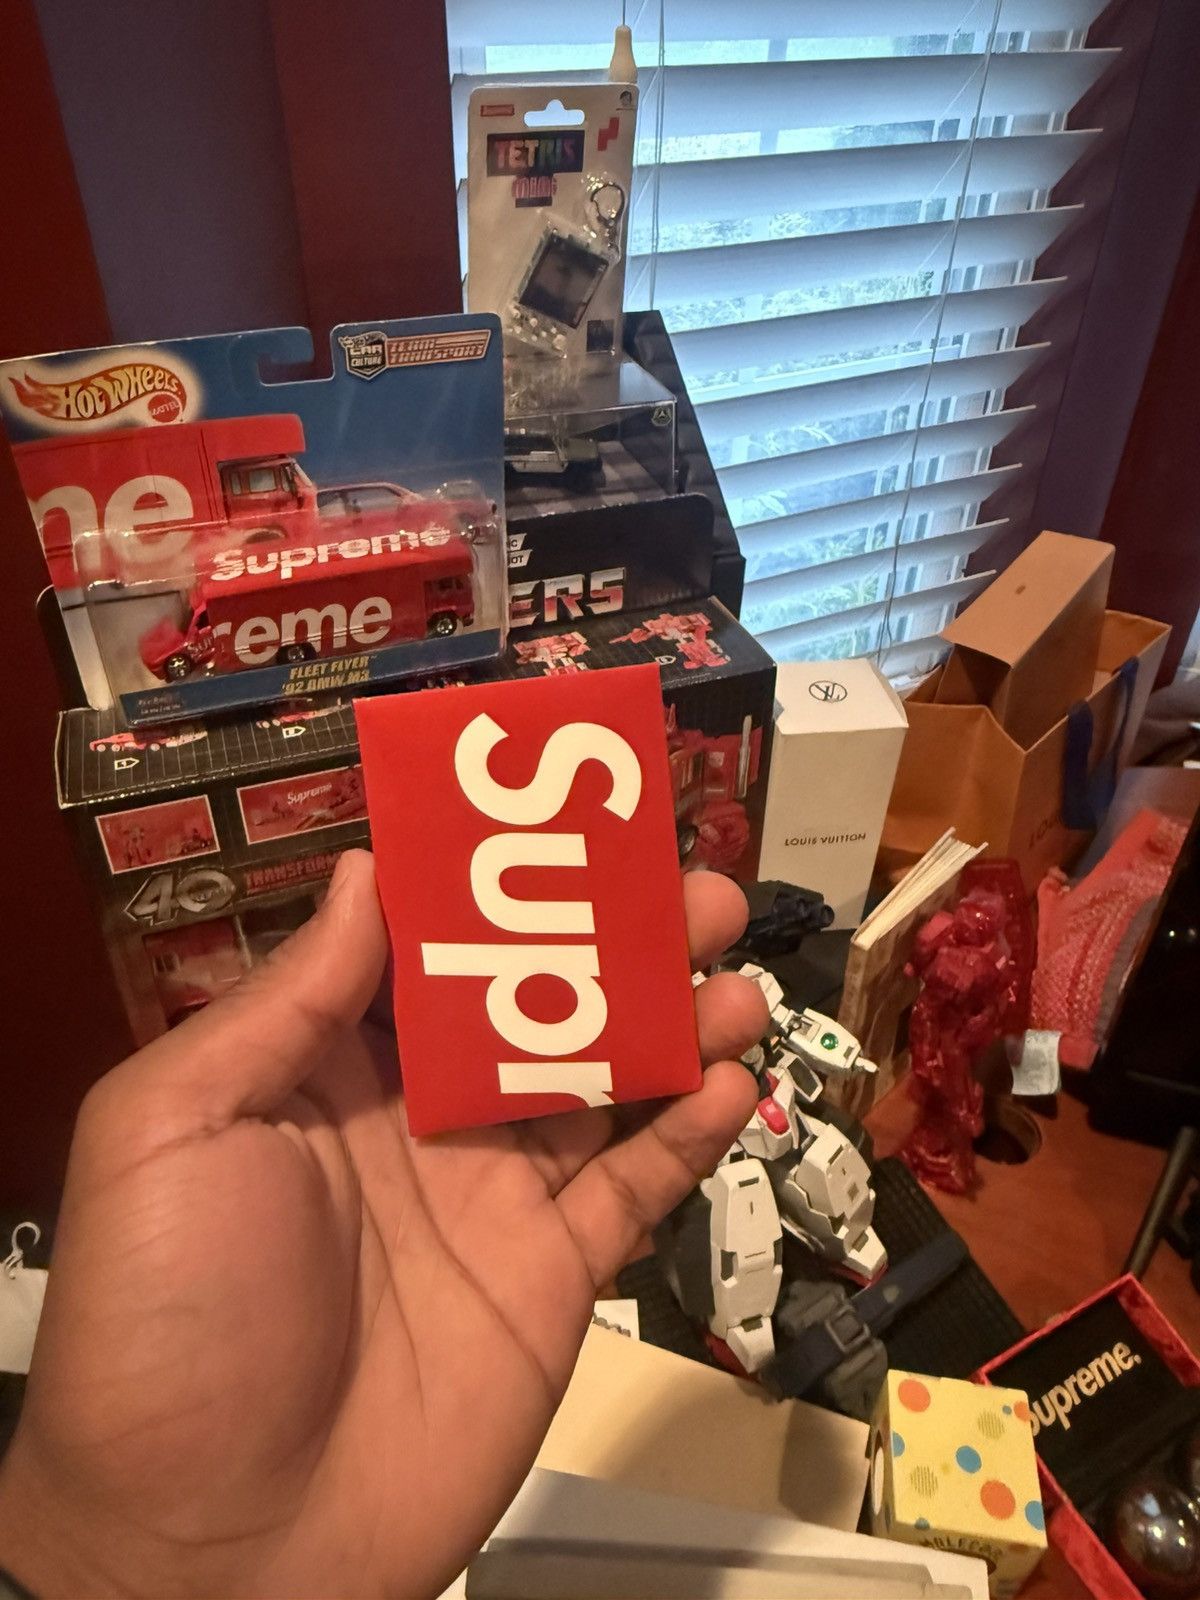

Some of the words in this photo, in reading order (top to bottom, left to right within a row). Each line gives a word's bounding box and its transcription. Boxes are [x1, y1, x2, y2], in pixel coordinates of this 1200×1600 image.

[350, 344, 383, 355] CAR
[351, 356, 383, 367] CULTURE
[210, 523, 451, 580] Supreme
[289, 663, 328, 680] FLEET
[784, 835, 817, 847] LOUIS
[820, 832, 867, 846] VUITTON
[132, 868, 238, 921] 40
